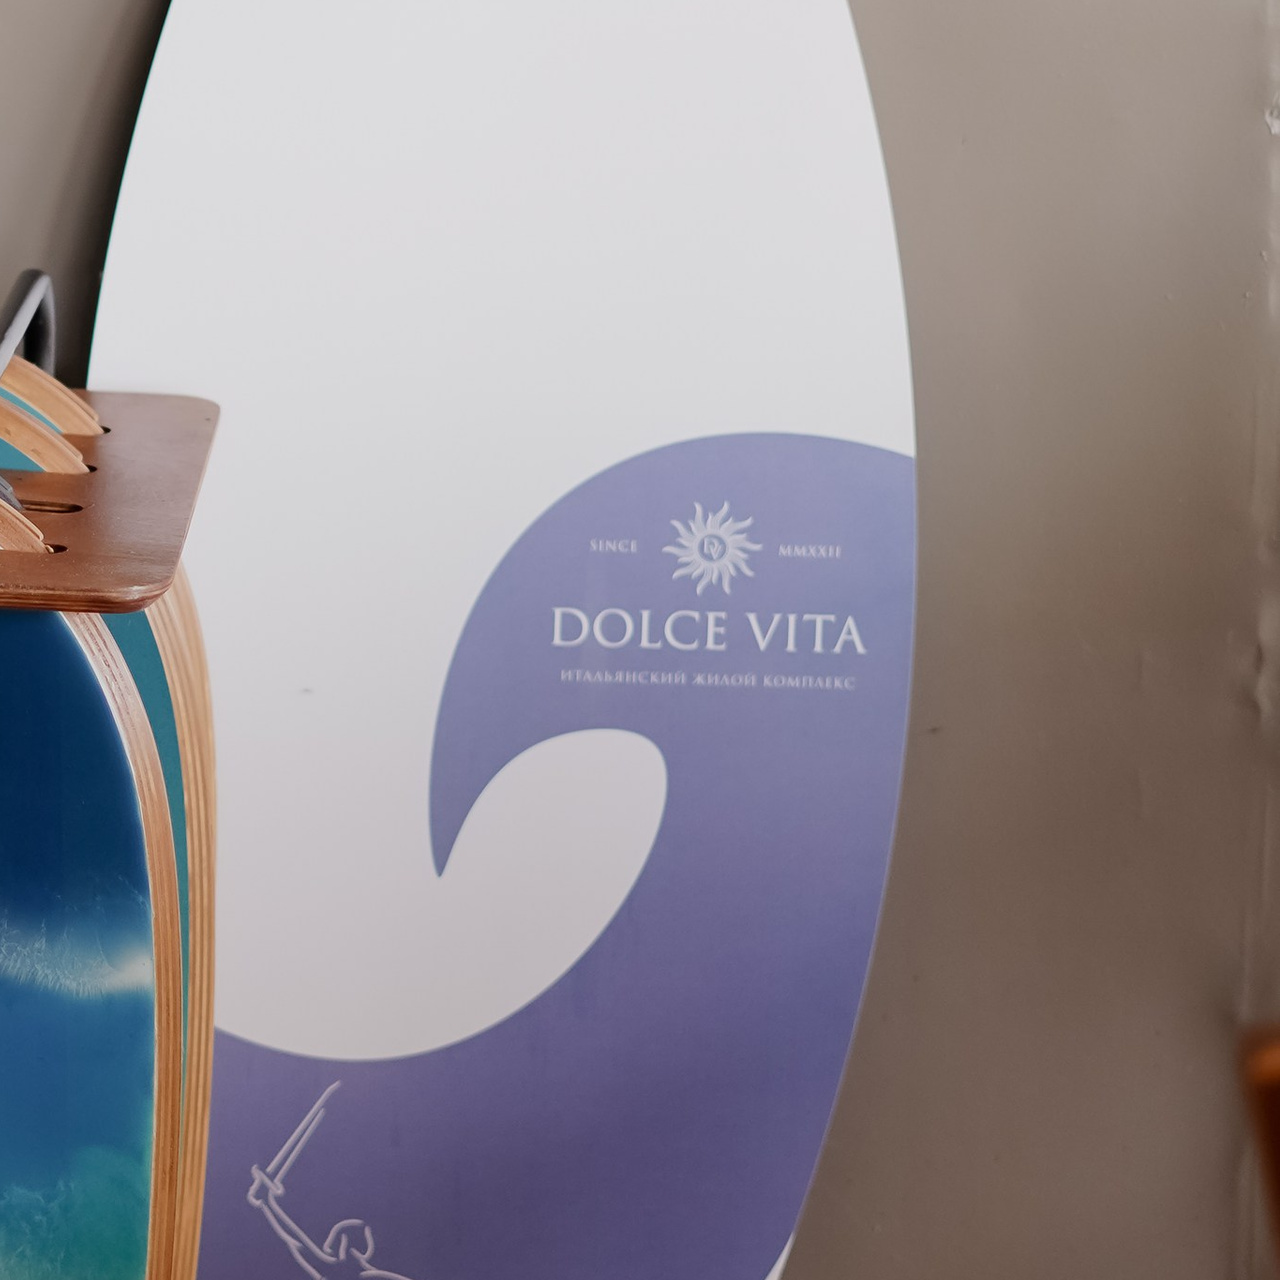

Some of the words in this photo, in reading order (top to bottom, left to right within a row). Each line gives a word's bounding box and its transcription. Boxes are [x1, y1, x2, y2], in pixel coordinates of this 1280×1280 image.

[589, 538, 638, 554] SINCE
[778, 543, 842, 559] MMXXII
[551, 606, 728, 652] DOLCE
[744, 611, 868, 655] VITA
[560, 669, 687, 685] ИТАЛЬЯНСКИЙ
[692, 671, 757, 688] ЖИЛОЙ
[763, 674, 856, 690] КОМПЛЕКС
